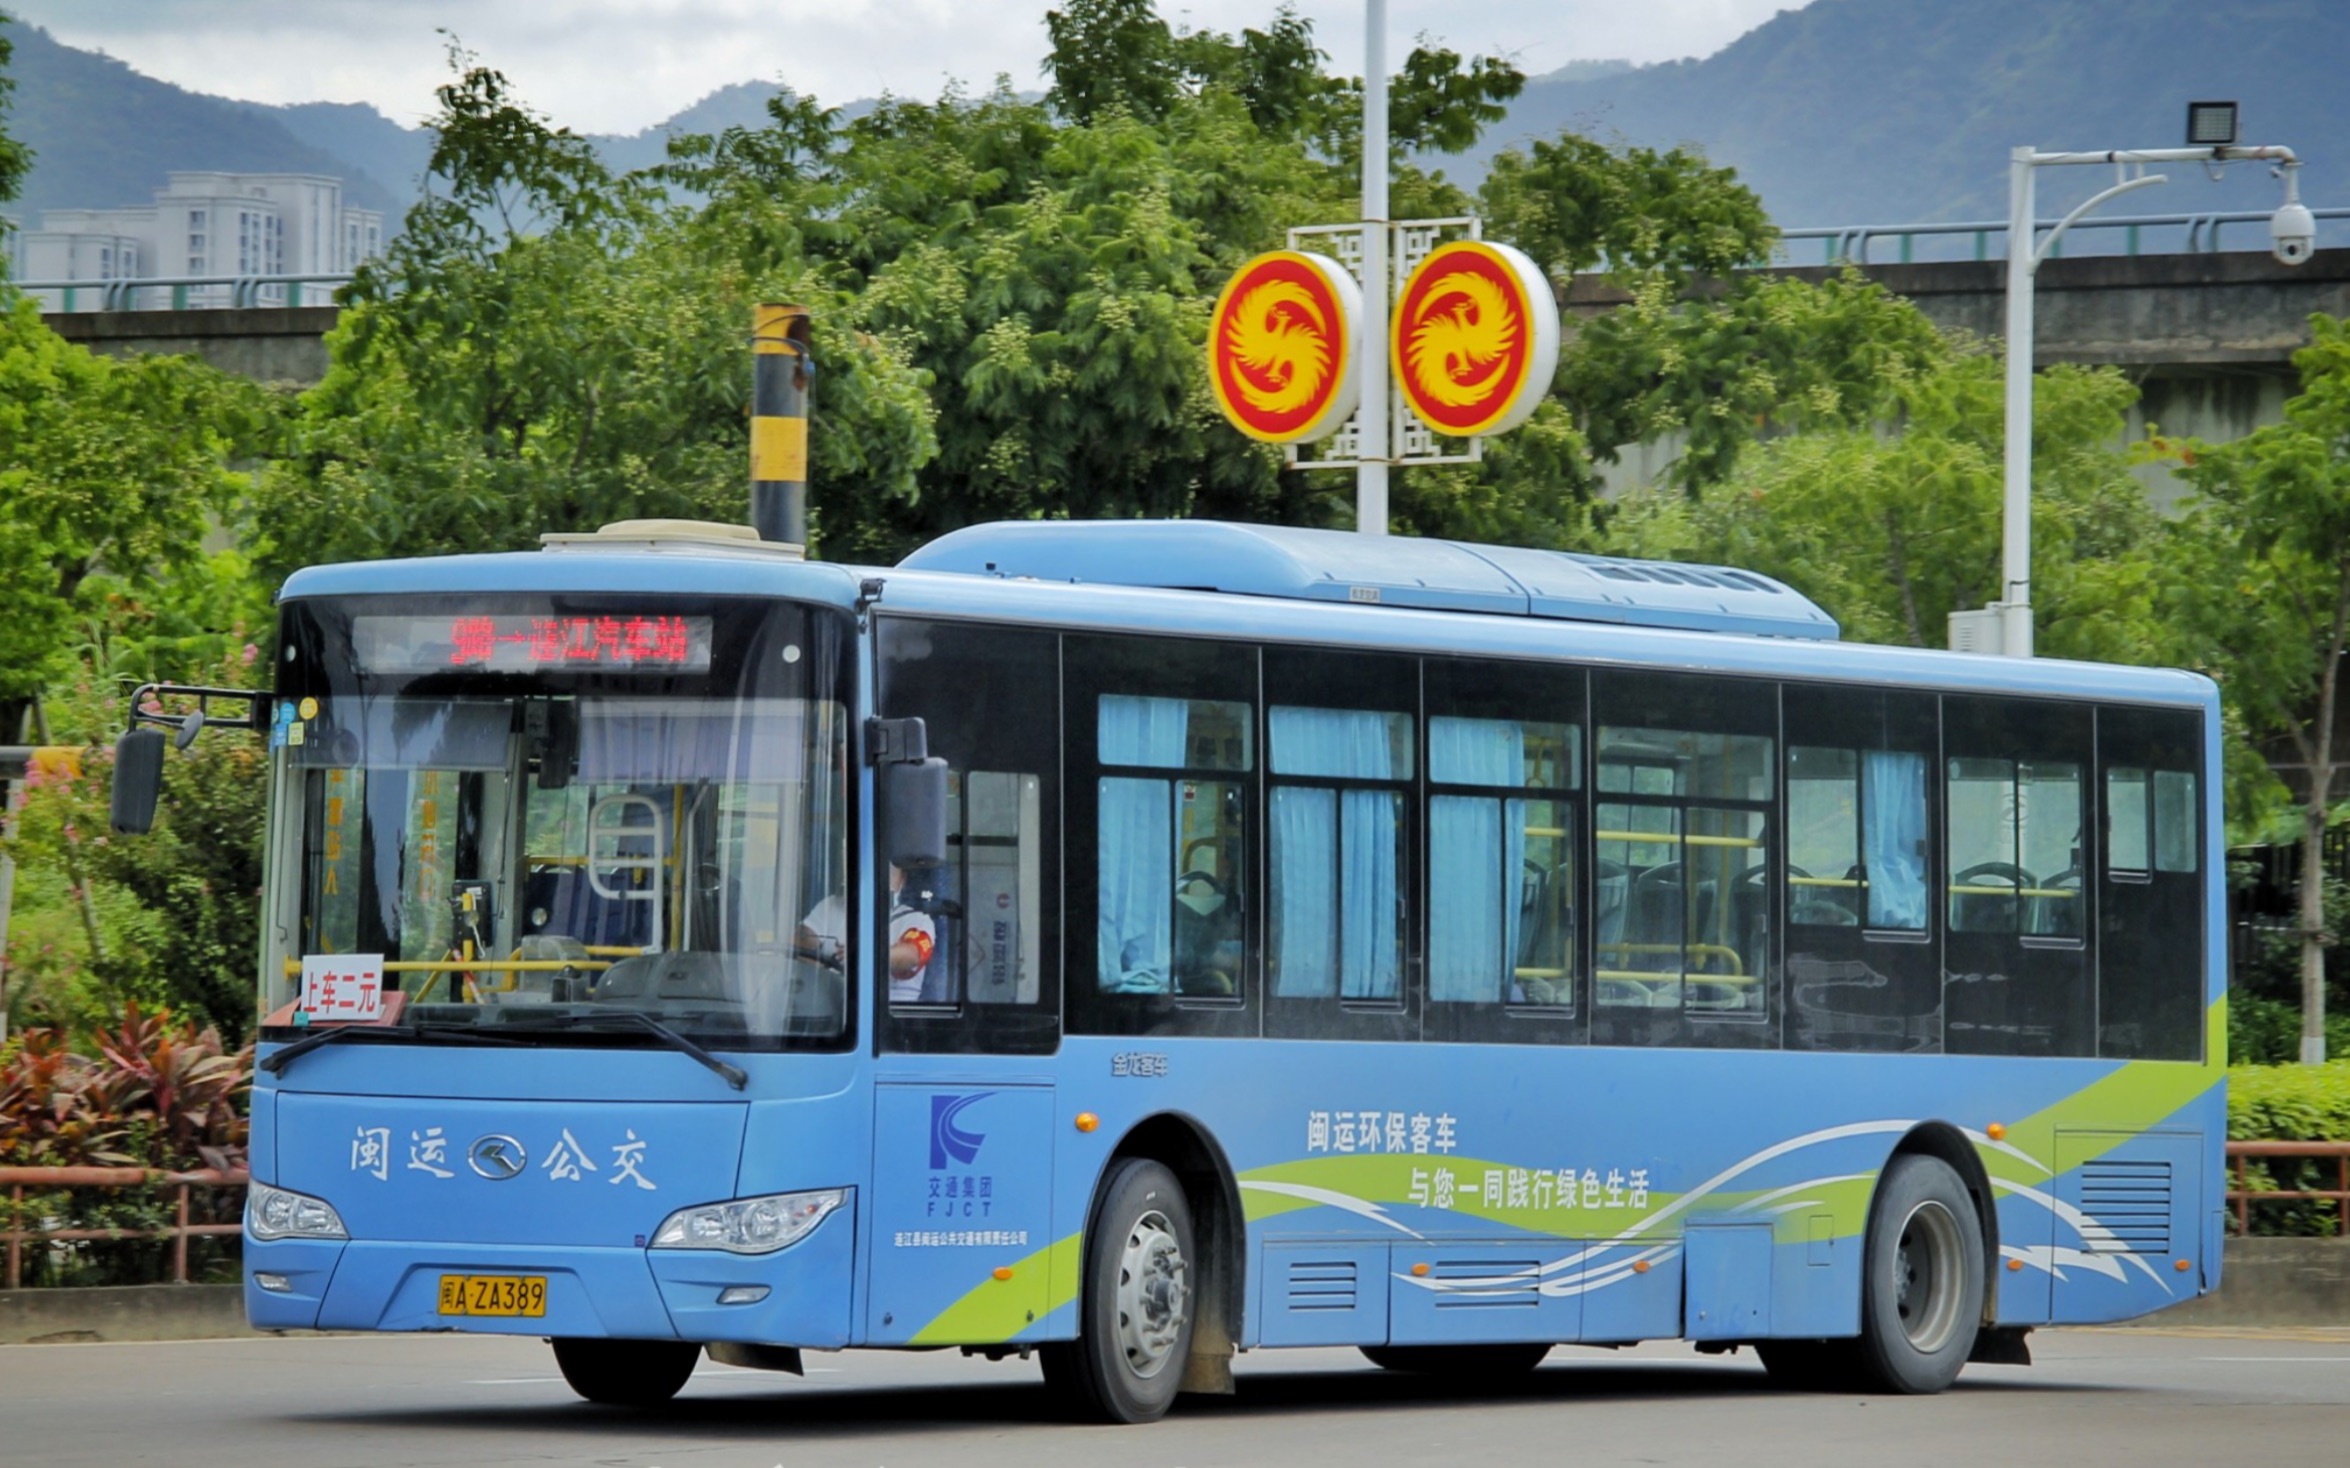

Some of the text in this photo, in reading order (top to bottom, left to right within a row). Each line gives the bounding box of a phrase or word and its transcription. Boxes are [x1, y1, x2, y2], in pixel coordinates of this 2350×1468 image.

[303, 970, 377, 1014] 上车二元
[1111, 1052, 1168, 1077] 金龙客车
[1307, 1110, 1457, 1154] 闽运环保客车
[351, 1126, 657, 1190] 闽运 公交
[929, 1176, 992, 1198] 交通集团
[1408, 1167, 1650, 1209] 与您一同践行绿色生活
